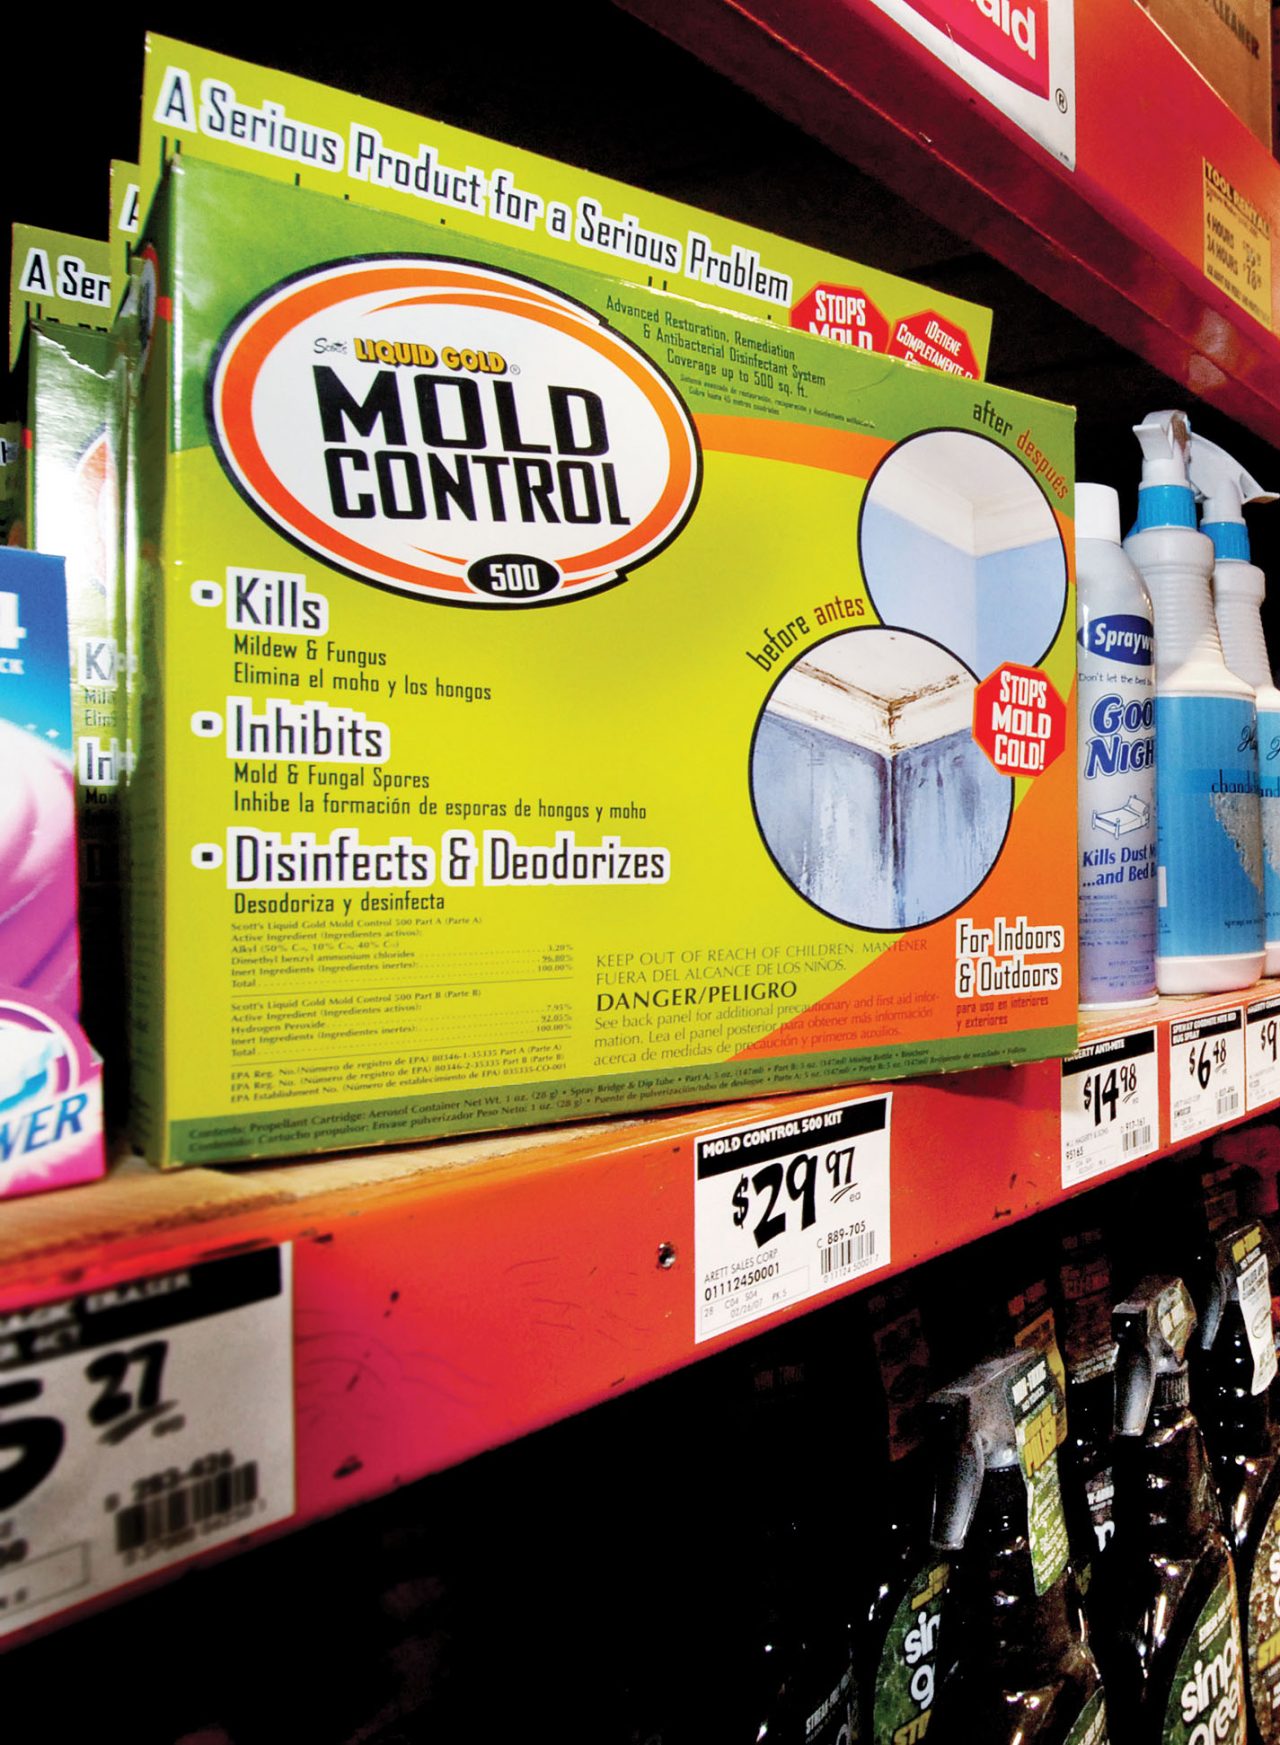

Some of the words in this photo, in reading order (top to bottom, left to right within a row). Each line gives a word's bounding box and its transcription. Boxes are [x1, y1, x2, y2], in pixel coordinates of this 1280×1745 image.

[970, 0, 1036, 60] aid
[1213, 0, 1260, 60] LEANER
[163, 75, 188, 125] A
[209, 87, 336, 164] Serious
[356, 133, 481, 208] Product
[495, 175, 538, 223] for
[552, 206, 566, 233] a
[581, 203, 677, 267] Serious
[691, 238, 788, 301] Problem
[1206, 161, 1234, 203] TOOL
[27, 253, 46, 289] A
[63, 261, 111, 302] Ser
[607, 296, 659, 323] Advanced
[665, 311, 729, 343] Restoration,
[735, 331, 795, 360] Remediation
[815, 290, 866, 327] STOPS
[354, 338, 438, 367] LIQUID
[442, 346, 508, 374] GOLD
[643, 323, 651, 340] &
[656, 329, 724, 359] Antibacterial
[730, 347, 788, 376] Disinfectant
[792, 365, 826, 386] System
[667, 348, 717, 375] Coverage
[722, 367, 734, 382] up
[739, 369, 748, 383] to
[754, 371, 774, 389] 500
[778, 381, 793, 397] sq.
[797, 381, 808, 398] ft.
[313, 365, 610, 457] MOLD
[972, 400, 1013, 437] after
[1017, 430, 1068, 500] después
[324, 447, 631, 527] CONTROL
[490, 563, 540, 592] 500
[236, 575, 321, 631] Kills
[234, 634, 297, 661] Mildew
[306, 639, 319, 661] &
[327, 642, 388, 668] Fungus
[746, 615, 811, 673] before
[814, 596, 865, 625] antes
[1095, 622, 1153, 655] Sprayw
[234, 663, 300, 688] Elimina
[309, 668, 323, 690] el
[333, 673, 379, 694] moho
[388, 678, 397, 698] y
[405, 675, 428, 697] los
[435, 678, 492, 702] hongos
[1000, 670, 1047, 709] STOPS
[1078, 672, 1103, 683] Don't
[1107, 673, 1117, 683] let
[1121, 673, 1133, 685] the
[236, 704, 383, 759] Inhibits
[992, 702, 1051, 739] MOLD
[1092, 693, 1154, 736] GOO
[994, 735, 1045, 770] COLD!
[1087, 736, 1154, 778] NIGH
[234, 763, 277, 784] Mold
[287, 764, 299, 785] &
[308, 765, 364, 790] Fungal
[373, 767, 430, 791] Spores
[234, 791, 290, 814] Inhibe
[299, 794, 315, 815] la
[323, 794, 411, 816] formación
[419, 797, 437, 817] de
[445, 800, 507, 821] esporas
[514, 798, 532, 818] de
[538, 800, 590, 822] hongos
[596, 805, 604, 823] y
[609, 802, 647, 820] moho
[236, 835, 428, 882] Disinfects
[448, 836, 471, 880] &
[490, 837, 665, 880] Deodorizes
[1082, 849, 1116, 868] Kills
[1120, 847, 1147, 864] Dust
[1128, 864, 1149, 882] Bed
[234, 892, 334, 915] Desodoriza
[343, 899, 353, 917] y
[361, 892, 445, 912] desinfecta
[596, 953, 634, 968] KEEP
[640, 951, 675, 966] OUT
[681, 950, 702, 964] OF
[708, 947, 756, 962] REACH
[863, 938, 928, 953] MANTENER
[960, 922, 989, 954] For
[998, 921, 1061, 952] Indoors
[596, 970, 647, 986] FUERA
[653, 967, 680, 982] DEL
[685, 963, 751, 980] ALCANCE
[777, 960, 801, 975] LOS
[804, 957, 846, 973] NIÑOS.
[959, 963, 971, 993] &
[981, 960, 1059, 991] Outdoors
[594, 1017, 618, 1031] See
[622, 1013, 652, 1028] back
[656, 1010, 692, 1028] panel
[716, 1003, 774, 1021] additional
[776, 998, 850, 1018] precautionary
[876, 993, 894, 1007] first
[596, 980, 798, 1012] DANGER/PELIGRO
[956, 1002, 977, 1017] para
[1011, 996, 1049, 1009] interiores
[594, 1034, 643, 1048] mation.
[649, 1030, 670, 1044] Lea
[689, 1024, 723, 1042] panel
[727, 1021, 777, 1038] posterior
[780, 1019, 805, 1034] para
[808, 1014, 848, 1029] obtener
[875, 1007, 933, 1022] información
[965, 1013, 1009, 1029] exteriores
[593, 1052, 637, 1067] acerca
[661, 1043, 713, 1060] medidas
[734, 1034, 798, 1056] precaución
[811, 1030, 858, 1048] primeros
[1260, 1020, 1278, 1062] $9
[1189, 1041, 1211, 1090] $6
[1212, 1038, 1227, 1065] 48
[1083, 1068, 1120, 1127] $14
[1120, 1062, 1138, 1093] 98
[702, 1135, 742, 1159] MOLD
[743, 1121, 801, 1148] CONTROL
[802, 1114, 823, 1133] 500
[824, 1110, 843, 1126] KIT
[732, 1153, 818, 1249] $29
[826, 1146, 856, 1189] 97
[849, 1190, 862, 1203] ea
[827, 1220, 866, 1245] 889-705
[704, 1263, 730, 1285] ARETT
[731, 1255, 754, 1276] SALES
[756, 1248, 779, 1267] CORP
[704, 1262, 780, 1302] 01112450001
[1181, 1636, 1240, 1723] simp
